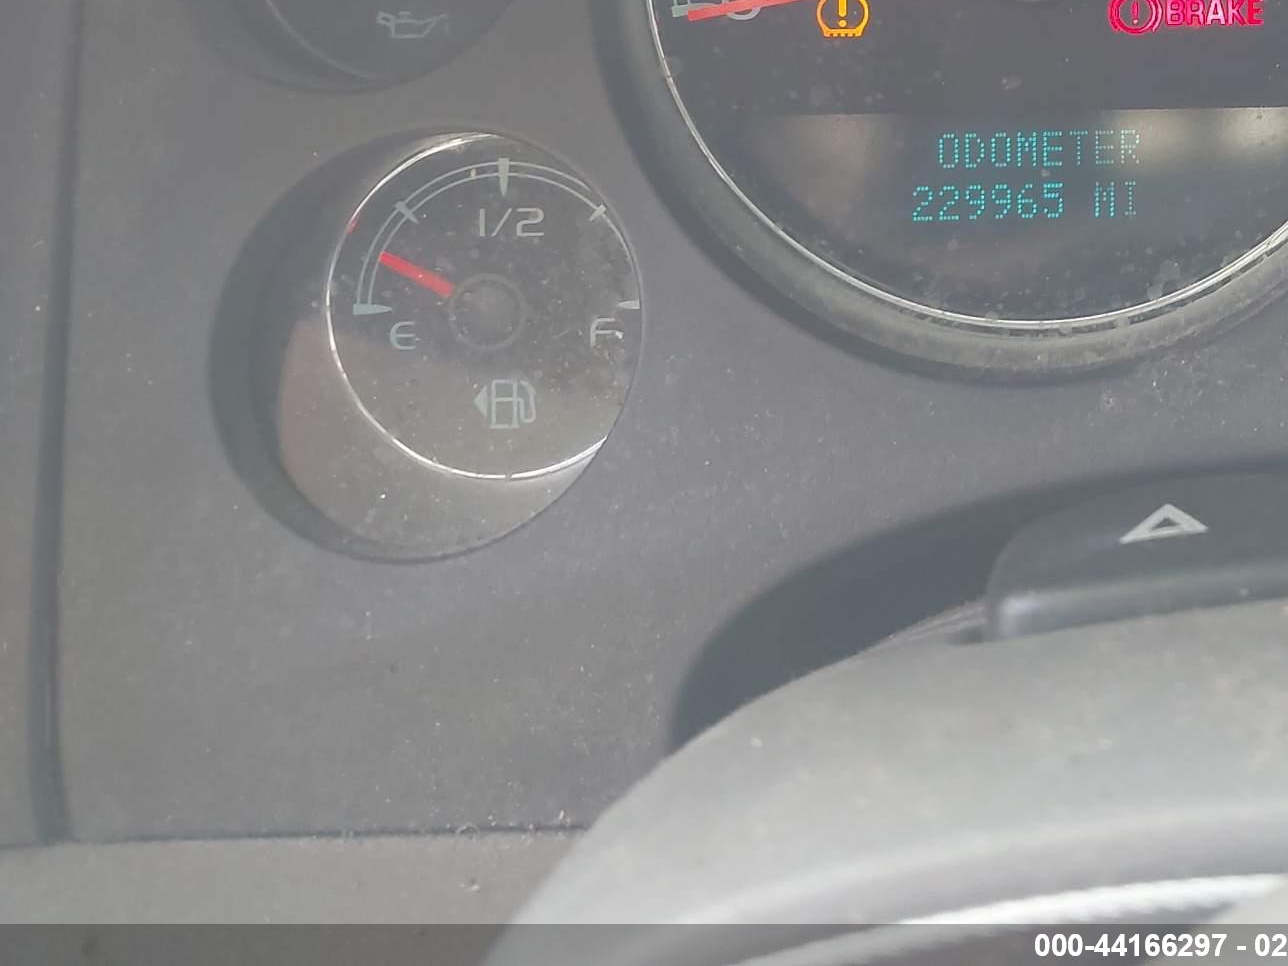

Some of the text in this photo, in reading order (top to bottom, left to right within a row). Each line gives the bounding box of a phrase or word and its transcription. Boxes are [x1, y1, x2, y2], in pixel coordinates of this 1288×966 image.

[938, 129, 1140, 168] ODOMETER
[912, 181, 1137, 222] 229965 MI
[478, 207, 545, 238] 1/2
[389, 320, 416, 350] E
[589, 317, 624, 347] F
